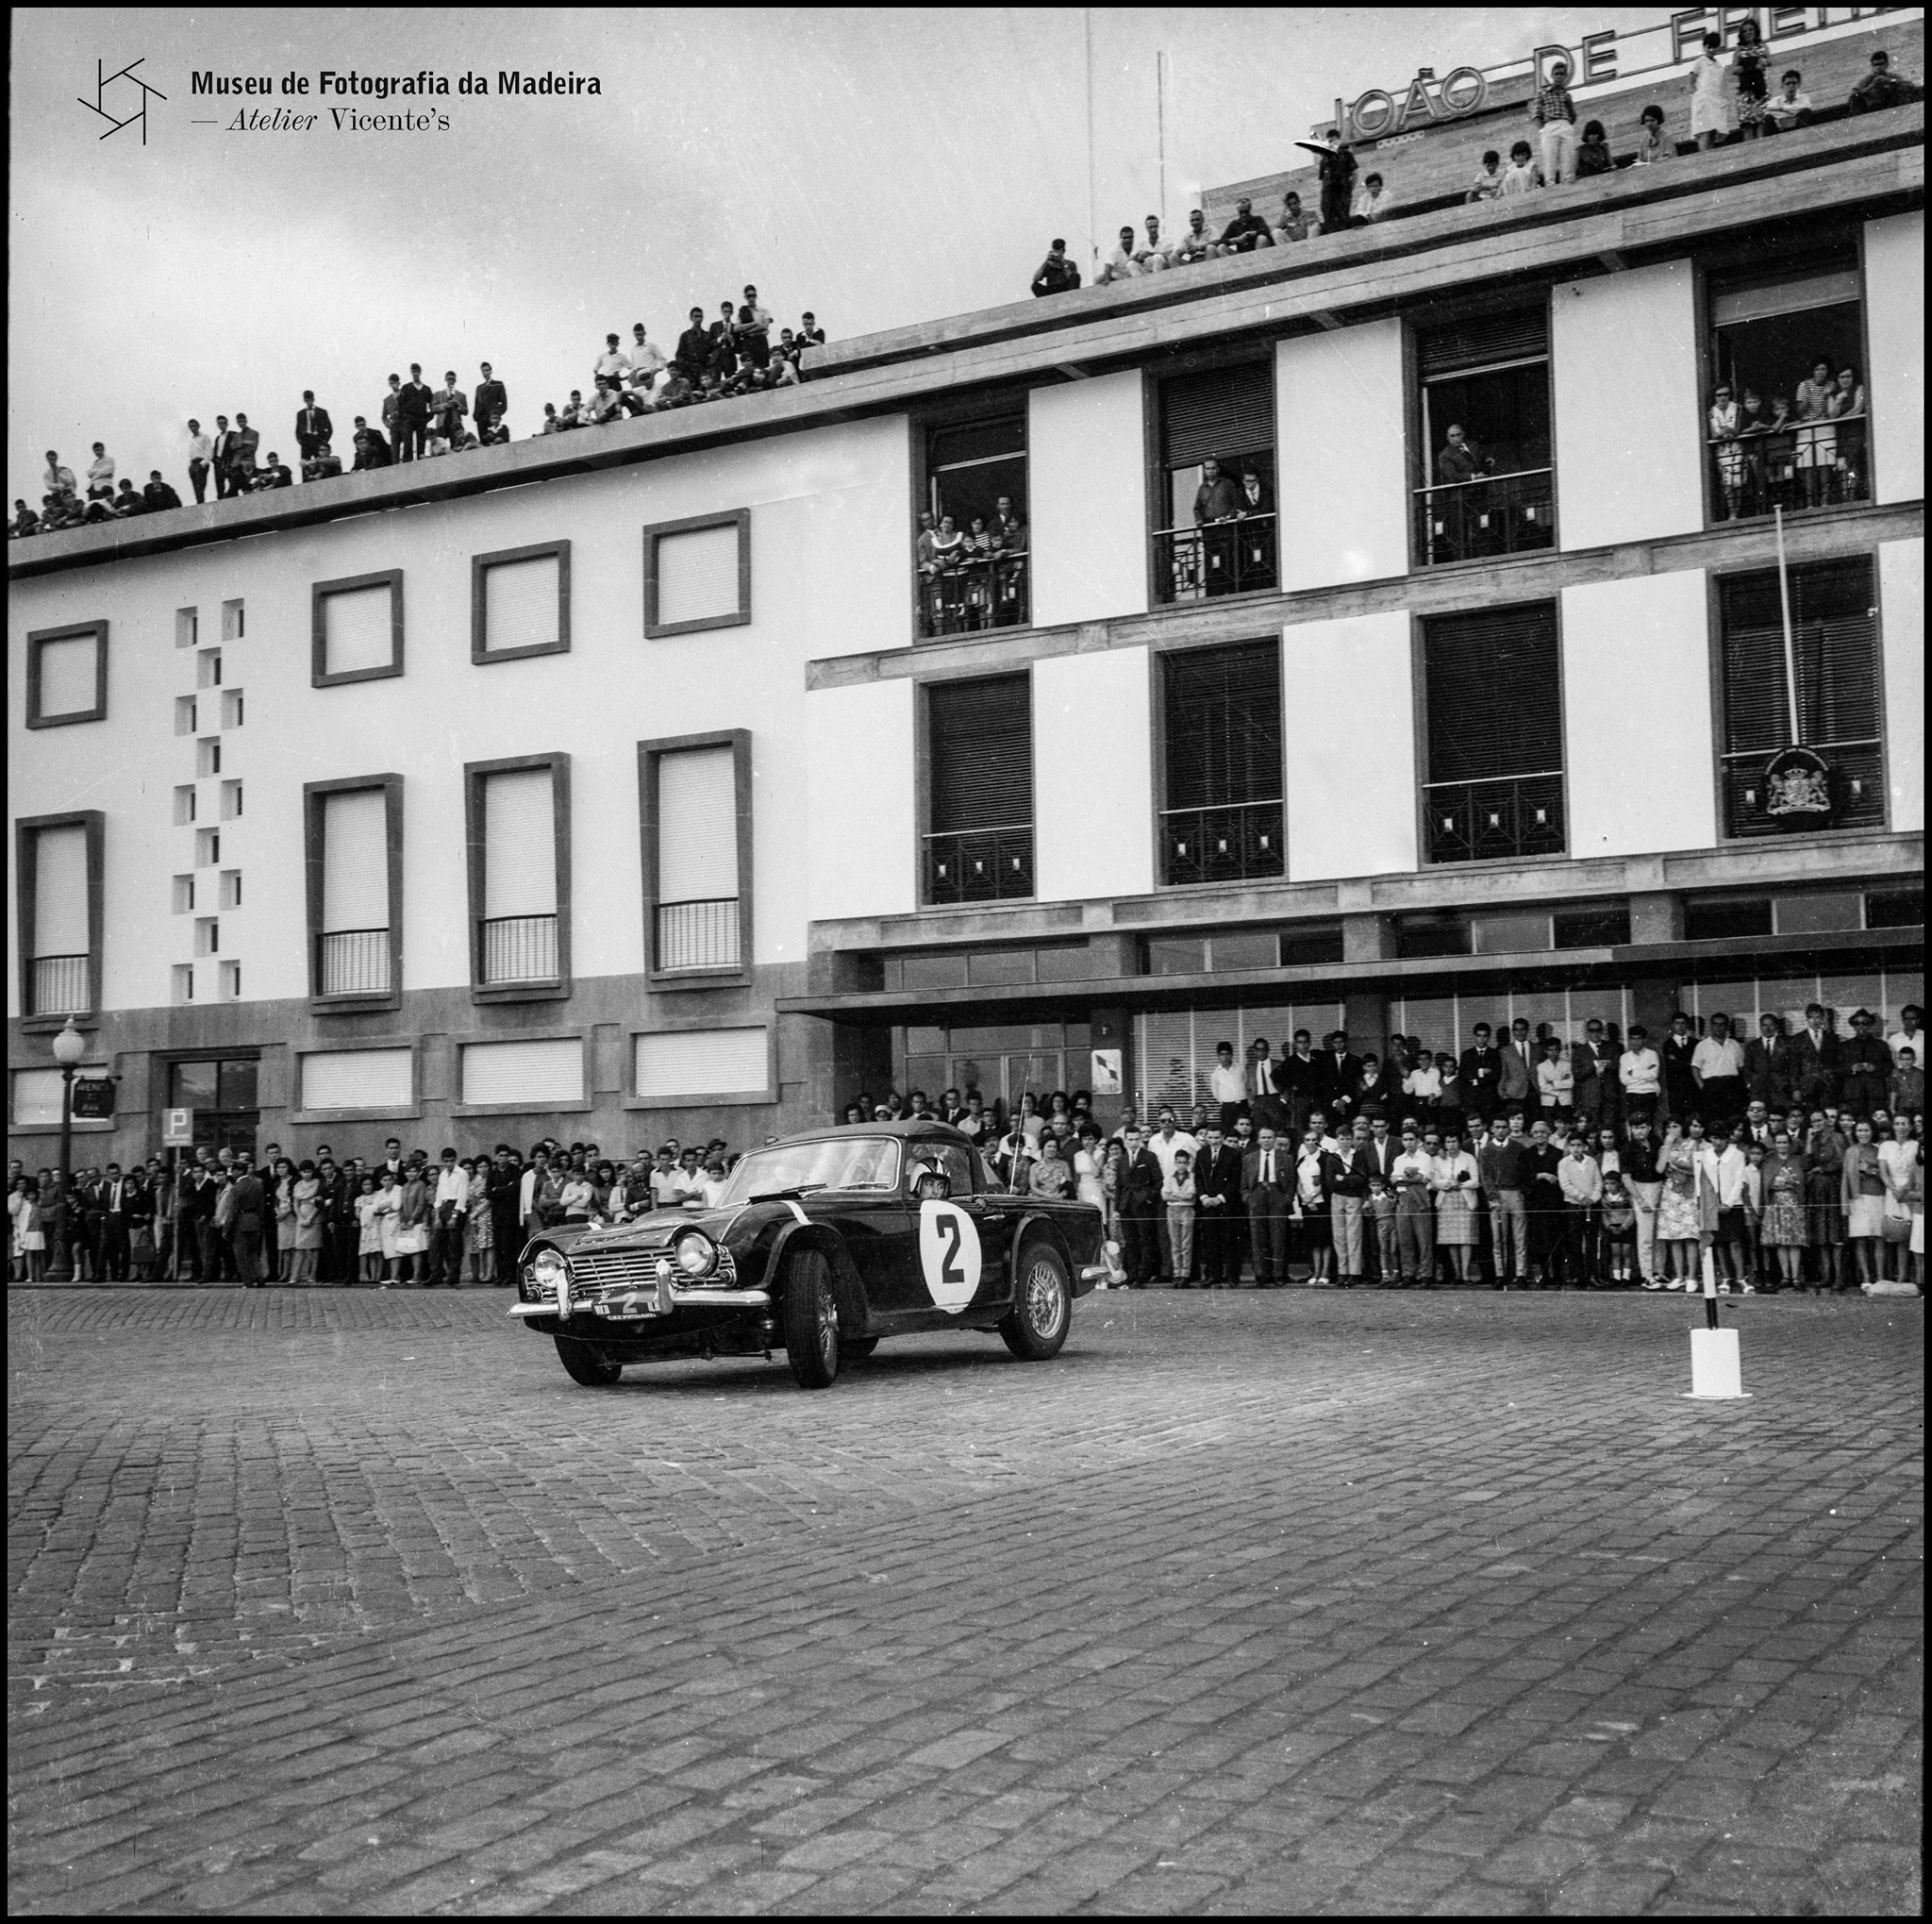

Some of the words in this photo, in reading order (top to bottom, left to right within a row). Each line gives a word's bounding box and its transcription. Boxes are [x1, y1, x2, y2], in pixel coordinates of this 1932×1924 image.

[1534, 29, 1618, 94] DE
[170, 1112, 187, 1135] P
[935, 1213, 966, 1284] 2
[623, 1292, 638, 1314] 2
[647, 1301, 662, 1313] ILH
